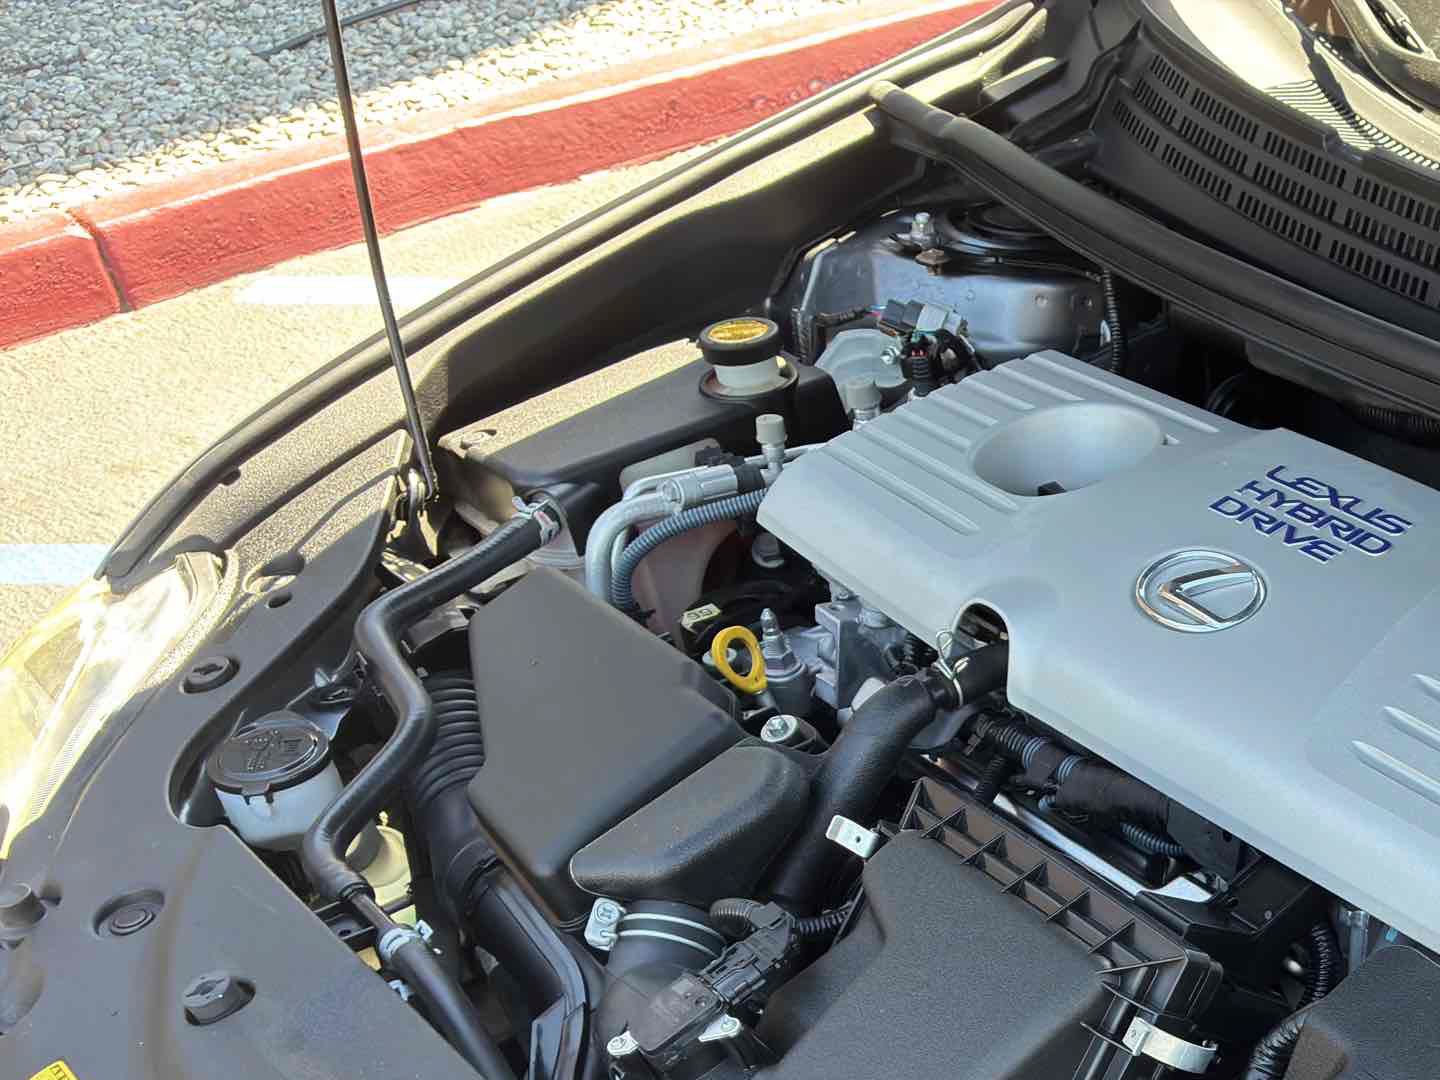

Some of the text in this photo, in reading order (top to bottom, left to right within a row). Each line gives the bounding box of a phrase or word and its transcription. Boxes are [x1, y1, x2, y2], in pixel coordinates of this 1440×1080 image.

[1209, 495, 1343, 564] DRIVE
[1235, 480, 1392, 556] HYBRID
[1266, 465, 1413, 535] LEXUS
